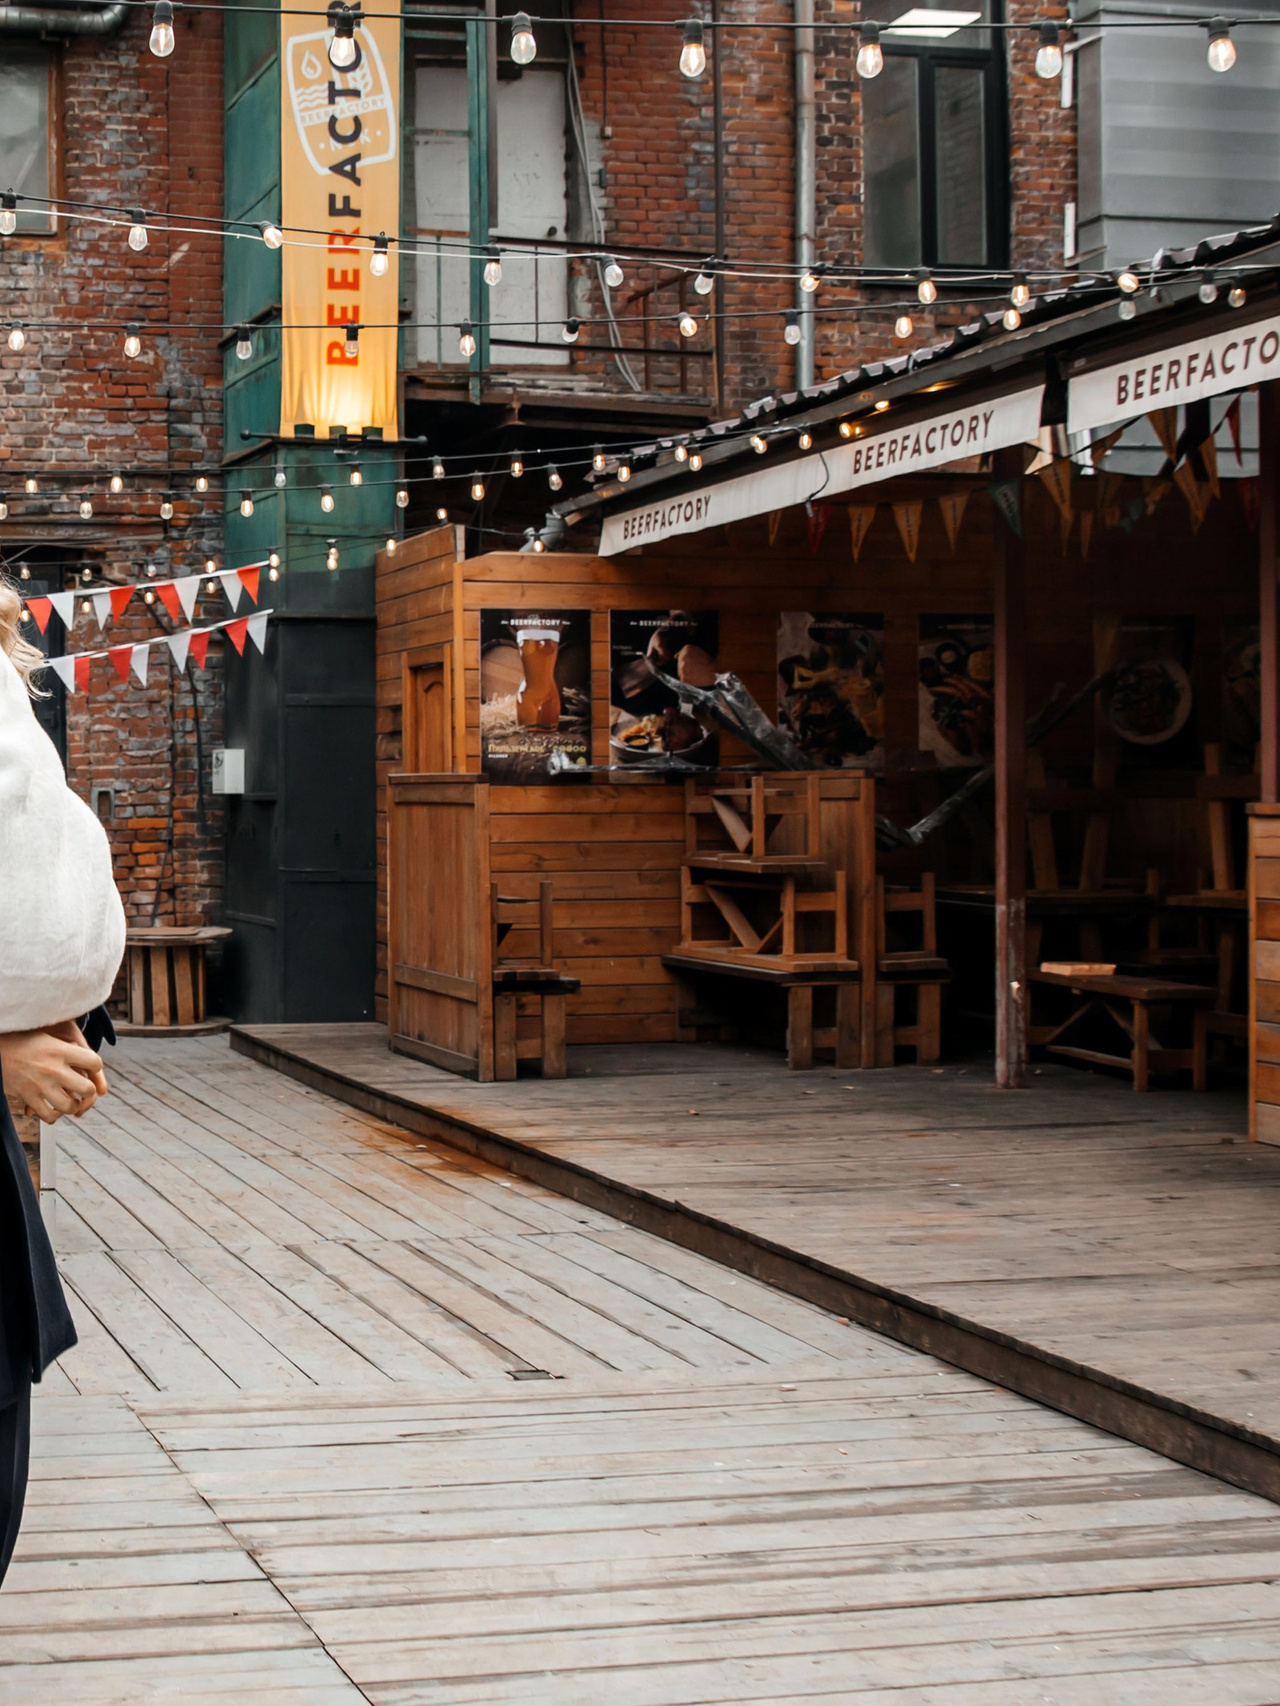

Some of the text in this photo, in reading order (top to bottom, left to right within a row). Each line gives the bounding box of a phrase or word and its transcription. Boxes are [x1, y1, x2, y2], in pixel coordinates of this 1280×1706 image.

[1116, 331, 1279, 406] BEERFACTO
[853, 410, 995, 475] BEERFACTORY
[623, 494, 711, 540] BEERFACTORY
